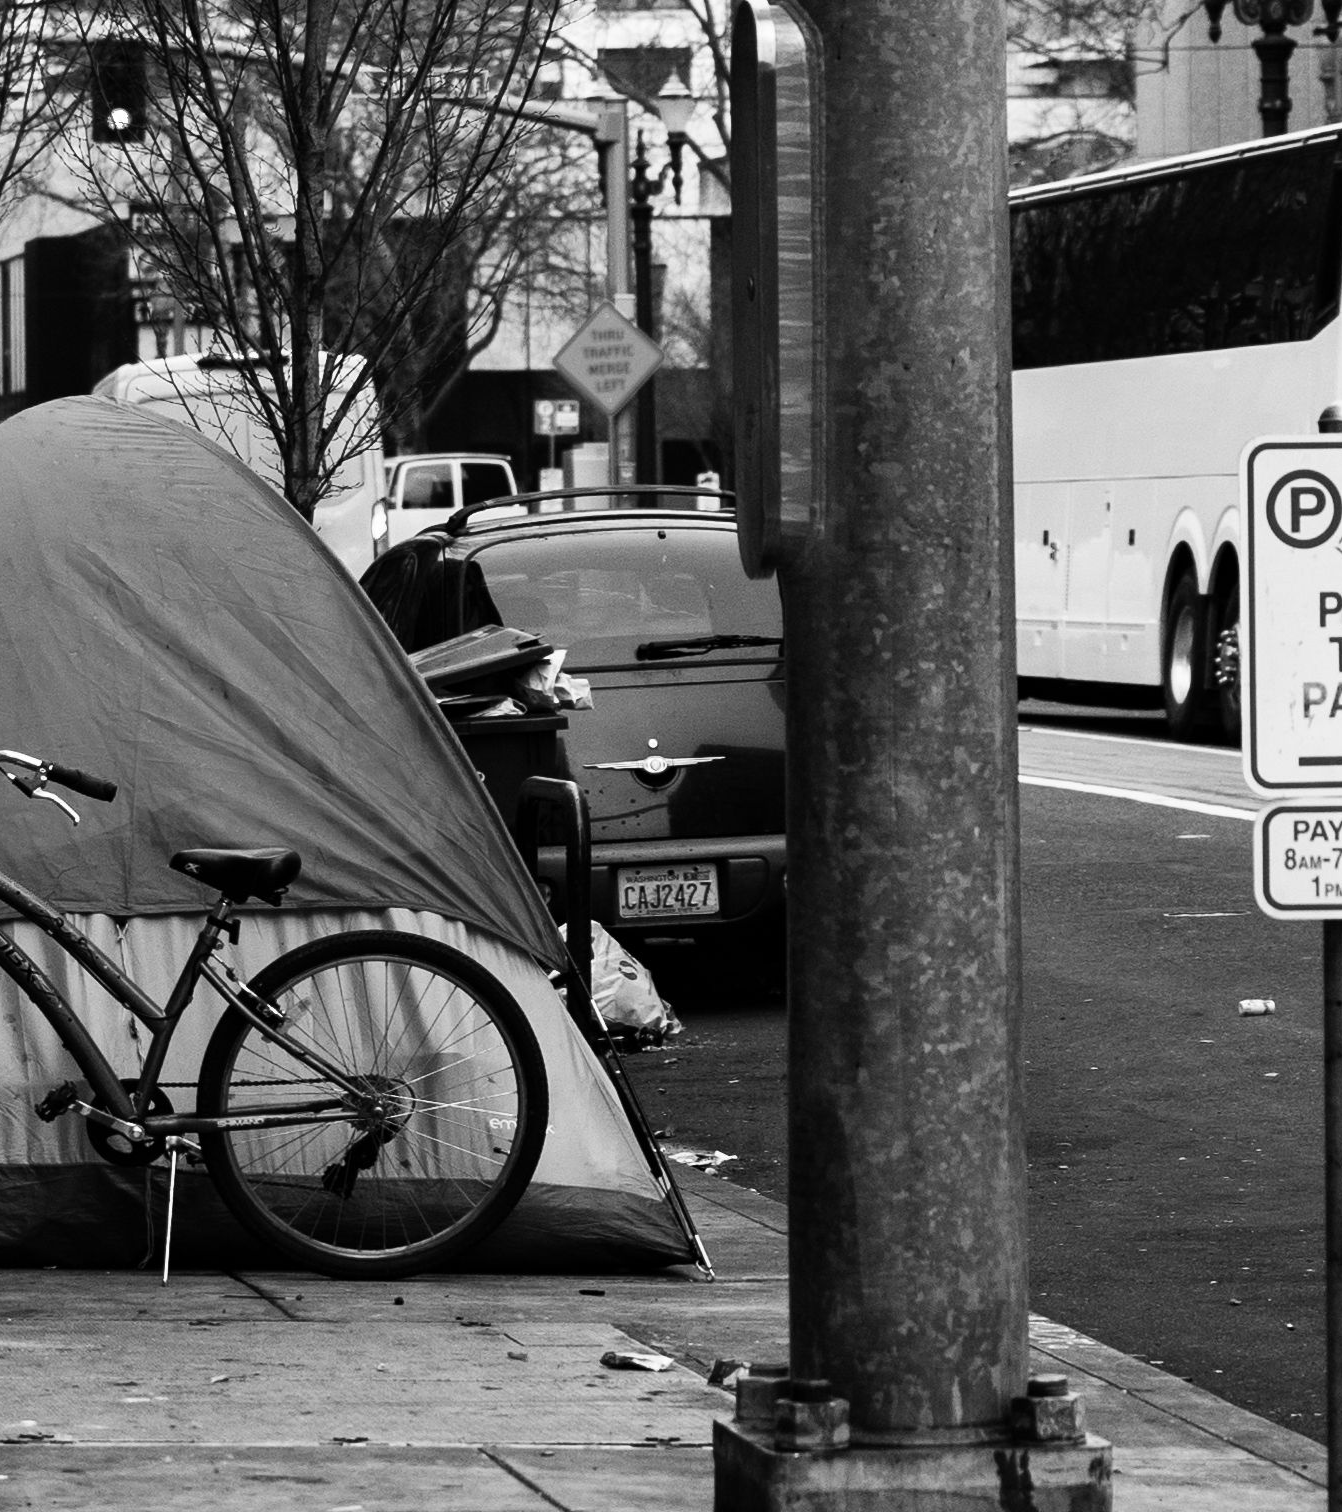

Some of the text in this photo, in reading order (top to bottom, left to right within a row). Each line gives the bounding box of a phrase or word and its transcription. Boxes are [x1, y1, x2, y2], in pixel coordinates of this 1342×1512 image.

[591, 329, 625, 341] THRU
[582, 344, 635, 358] TRAFFIC
[588, 361, 630, 375] MERGE
[596, 378, 626, 392] LEFT
[1290, 486, 1327, 533] P
[623, 881, 712, 910] CAJ2427
